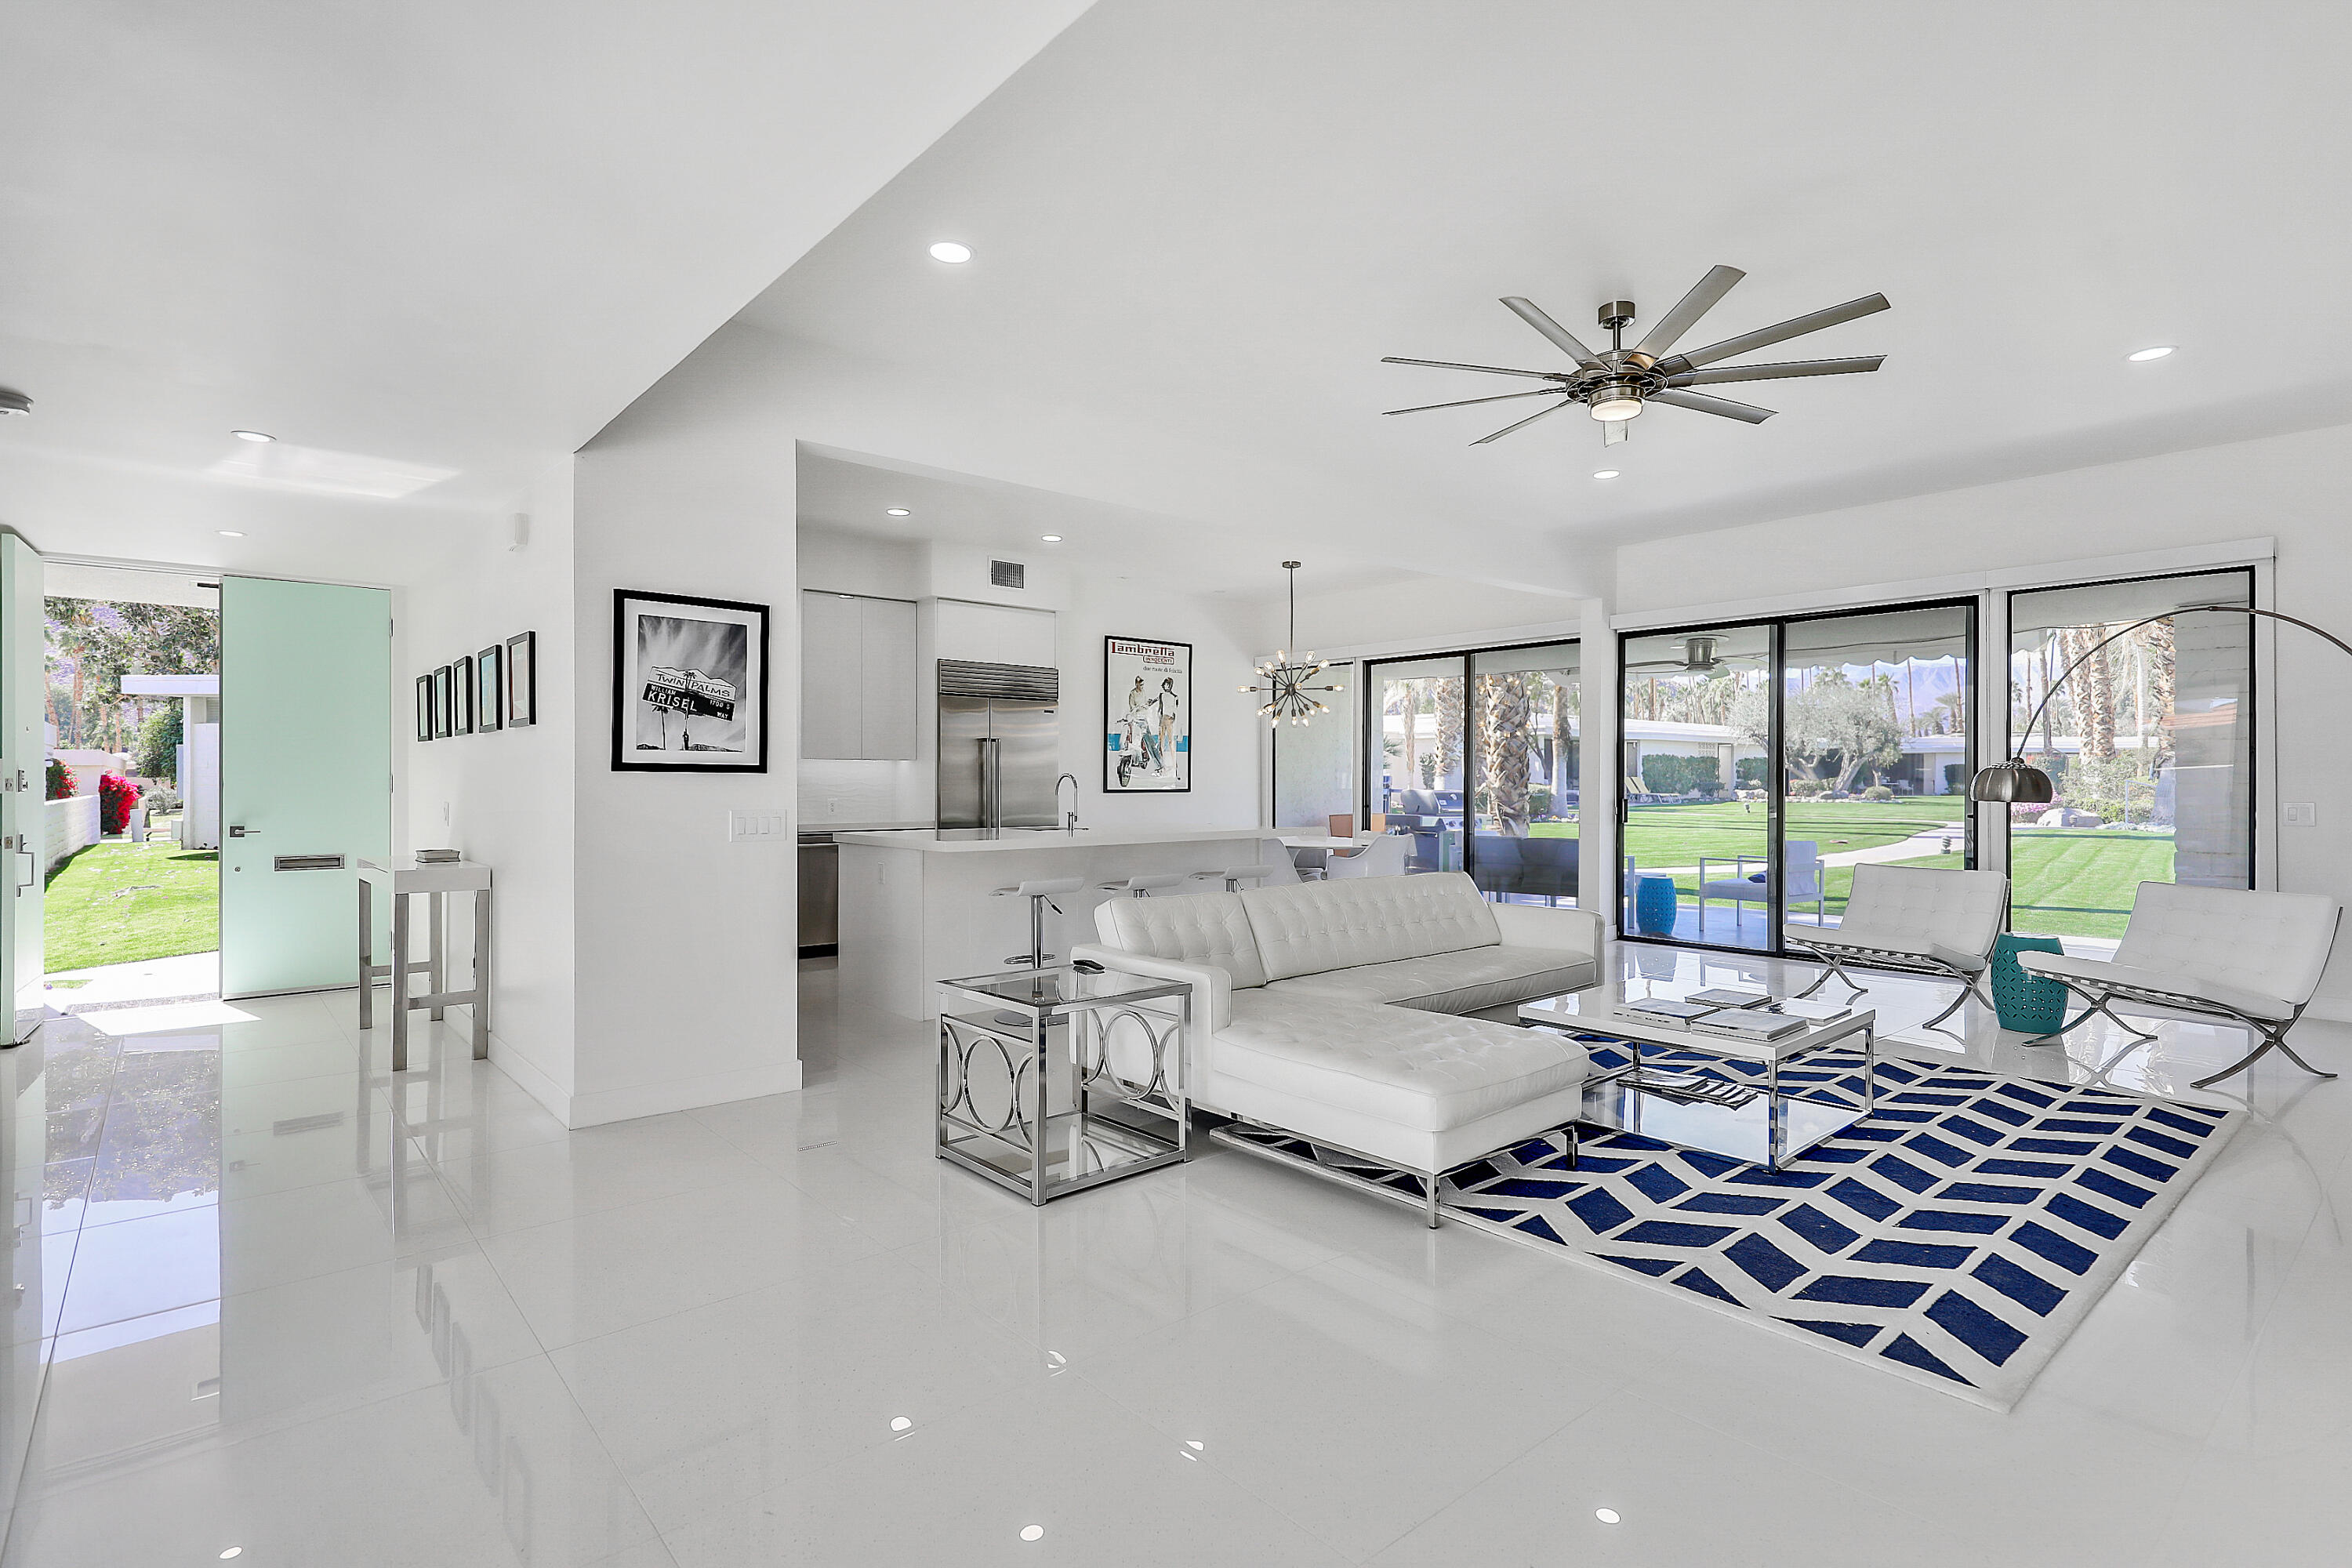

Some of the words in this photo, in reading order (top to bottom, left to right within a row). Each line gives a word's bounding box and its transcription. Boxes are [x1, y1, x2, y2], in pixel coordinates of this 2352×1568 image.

[1111, 641, 1174, 656] Lambretta
[651, 684, 677, 696] WILLIAM
[655, 673, 685, 687] TWIN
[691, 681, 731, 697] PALMS
[648, 690, 698, 712] KRISEL
[710, 699, 724, 708] 1700
